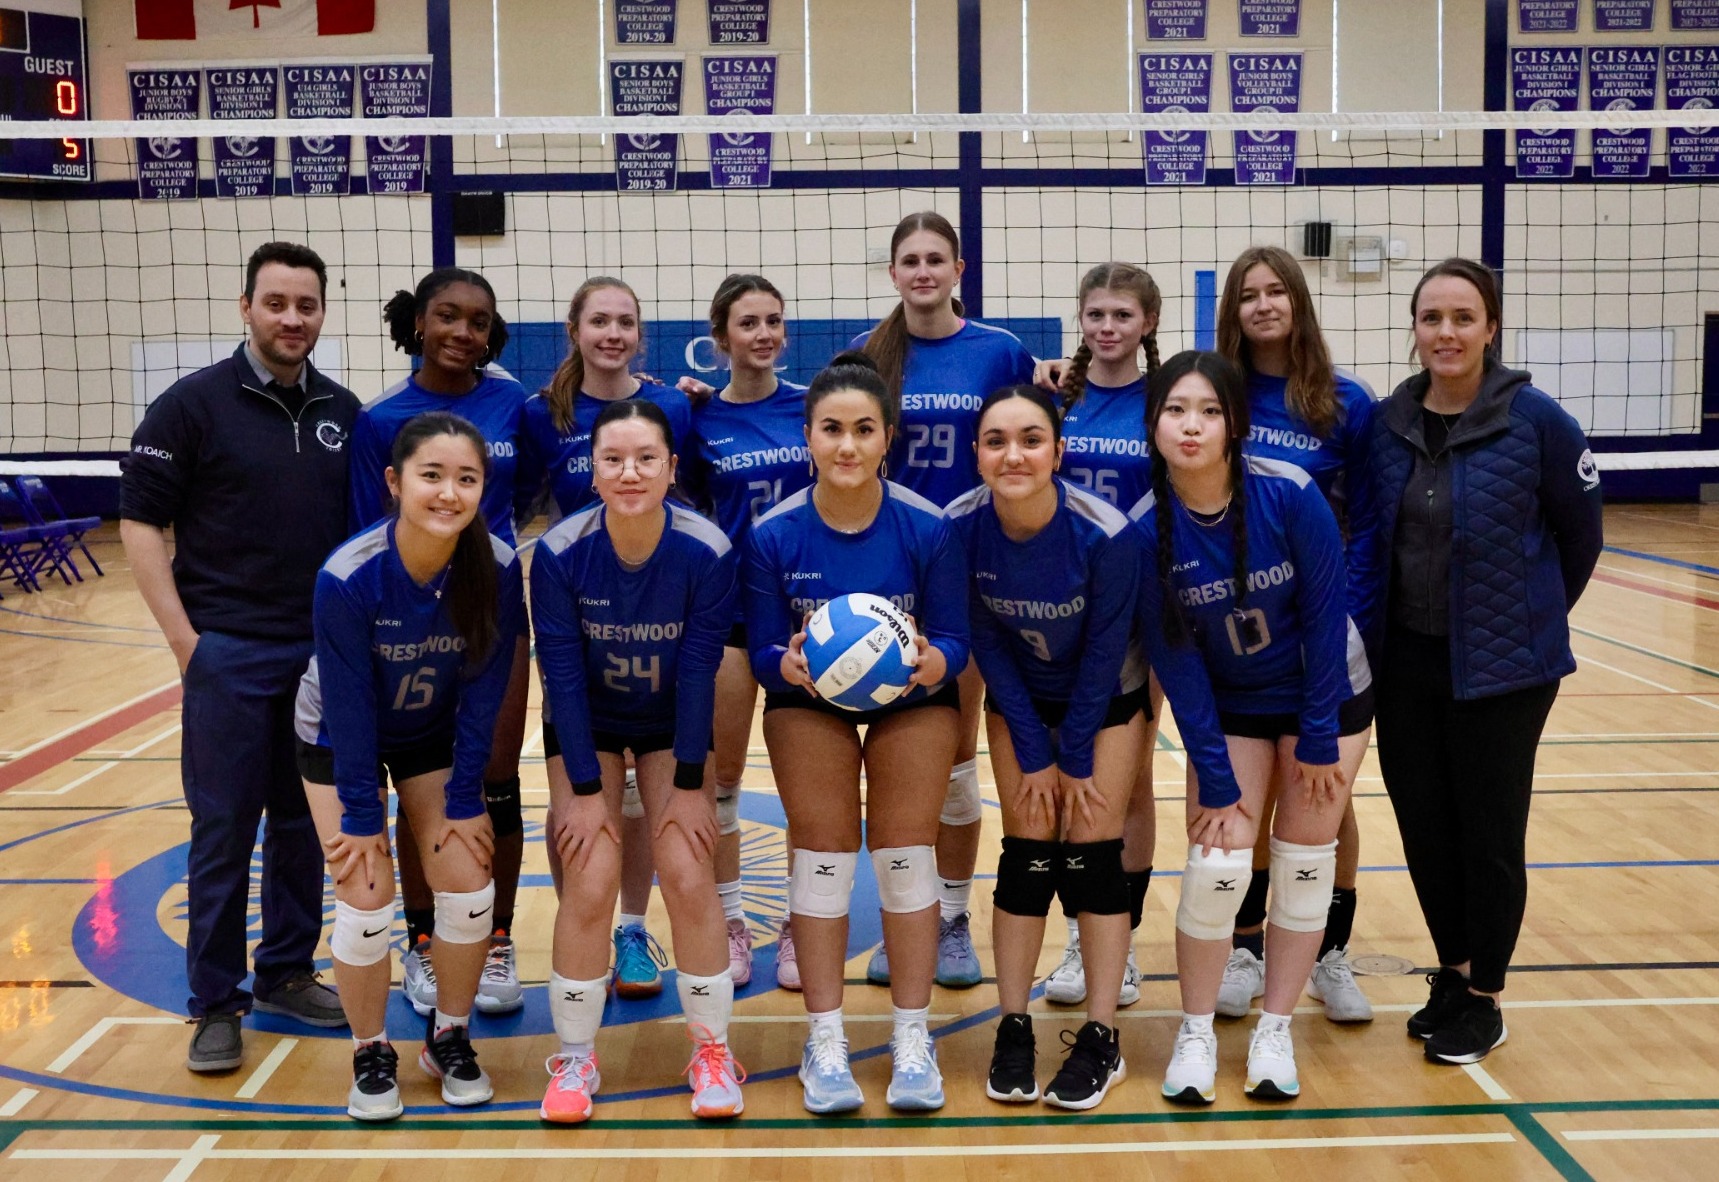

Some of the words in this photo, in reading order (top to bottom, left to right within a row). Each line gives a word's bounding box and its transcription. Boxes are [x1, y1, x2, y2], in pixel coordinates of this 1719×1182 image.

[1151, 0, 1201, 8] CRESTWOOD
[621, 5, 670, 13] CRESTWOOD
[1149, 9, 1204, 17] PREPARATORY
[1605, 9, 1642, 17] COLLEGE
[618, 14, 673, 22] PREPARATORY
[1251, 14, 1288, 22] COLLEGE
[1530, 10, 1566, 18] COLLEGE
[627, 23, 664, 31] COLLEGE
[720, 22, 758, 30] COLLEGE
[1257, 24, 1280, 34] 2021
[1164, 27, 1187, 37] 2021
[626, 32, 666, 42] 2019-20
[719, 32, 759, 42] 2019-20
[1515, 51, 1578, 63] CISAA
[1592, 51, 1655, 63] CISAA
[1668, 51, 1719, 62] CISA
[24, 56, 74, 76] GUEST
[707, 61, 772, 73] CISAA
[1143, 58, 1208, 70] CISAA
[1233, 58, 1298, 70] CISAA
[287, 69, 351, 82] CISAA
[363, 68, 427, 81] CISAA
[614, 65, 679, 78] CISAA
[1690, 71, 1719, 79] FOOTB
[133, 75, 197, 87] CISAA
[210, 71, 274, 85] CISAA
[743, 75, 768, 83] GIRLS
[215, 86, 245, 94] SENIOR
[246, 86, 272, 94] GIRLS
[369, 82, 399, 90] JUNIOR
[399, 82, 422, 90] BOYS
[139, 89, 168, 97] JUNIOR
[293, 91, 348, 99] BASKETBALL
[369, 89, 423, 97] BASKETBALL
[1515, 89, 1577, 98] CHAMPIONS
[1592, 88, 1653, 97] CHAMPIONS
[56, 81, 76, 115] 0
[216, 94, 271, 102] BASKETBALL
[373, 97, 409, 105] DIVISION
[709, 98, 772, 107] CHAMPIONS
[1145, 96, 1207, 105] CHAMPIONS
[1235, 96, 1296, 105] CHAMPIONS
[220, 101, 258, 109] DIVISION
[616, 103, 678, 112] CHAMPIONS
[213, 109, 274, 119] CHAMPIONS
[290, 107, 351, 116] CHAMPIONS
[366, 105, 426, 115] CHAMPIONS
[137, 112, 197, 120] CHAMPIONS
[716, 148, 765, 156] CRESTWOOD
[1240, 145, 1290, 153] CRESTWOOD
[1678, 154, 1715, 162] COLLEGE
[144, 161, 193, 169] CRESTWOOD
[619, 161, 674, 169] PREPARATORY
[722, 165, 759, 173] COLLEGE
[1536, 165, 1554, 174] 2022
[1612, 165, 1630, 174] 2022
[52, 164, 85, 176] SCORE
[141, 170, 195, 178] PREPARATORY
[227, 176, 264, 184] COLLEGE
[303, 174, 340, 182] COLLEGE
[378, 172, 414, 180] COLLEGE
[729, 175, 751, 185] 2021
[1163, 172, 1186, 182] 2021
[1253, 172, 1276, 182] 2021
[150, 178, 186, 186] COLLEGE
[627, 179, 666, 189] 2019-20
[235, 186, 258, 196] 2019
[310, 183, 333, 193] 2019
[384, 182, 407, 192] 2019
[156, 188, 180, 198] 2019
[901, 393, 984, 412] ESTWOOD
[707, 436, 734, 446] KUKRI
[1247, 425, 1323, 451] STWOOD
[906, 423, 956, 469] 29
[792, 572, 822, 580] KUKRI
[981, 594, 1085, 620] RESTWOOD
[869, 604, 910, 649] Wilson
[372, 635, 467, 662] RESTWOO
[1019, 628, 1052, 662] 9
[603, 651, 660, 693] 24
[392, 666, 438, 711] 15
